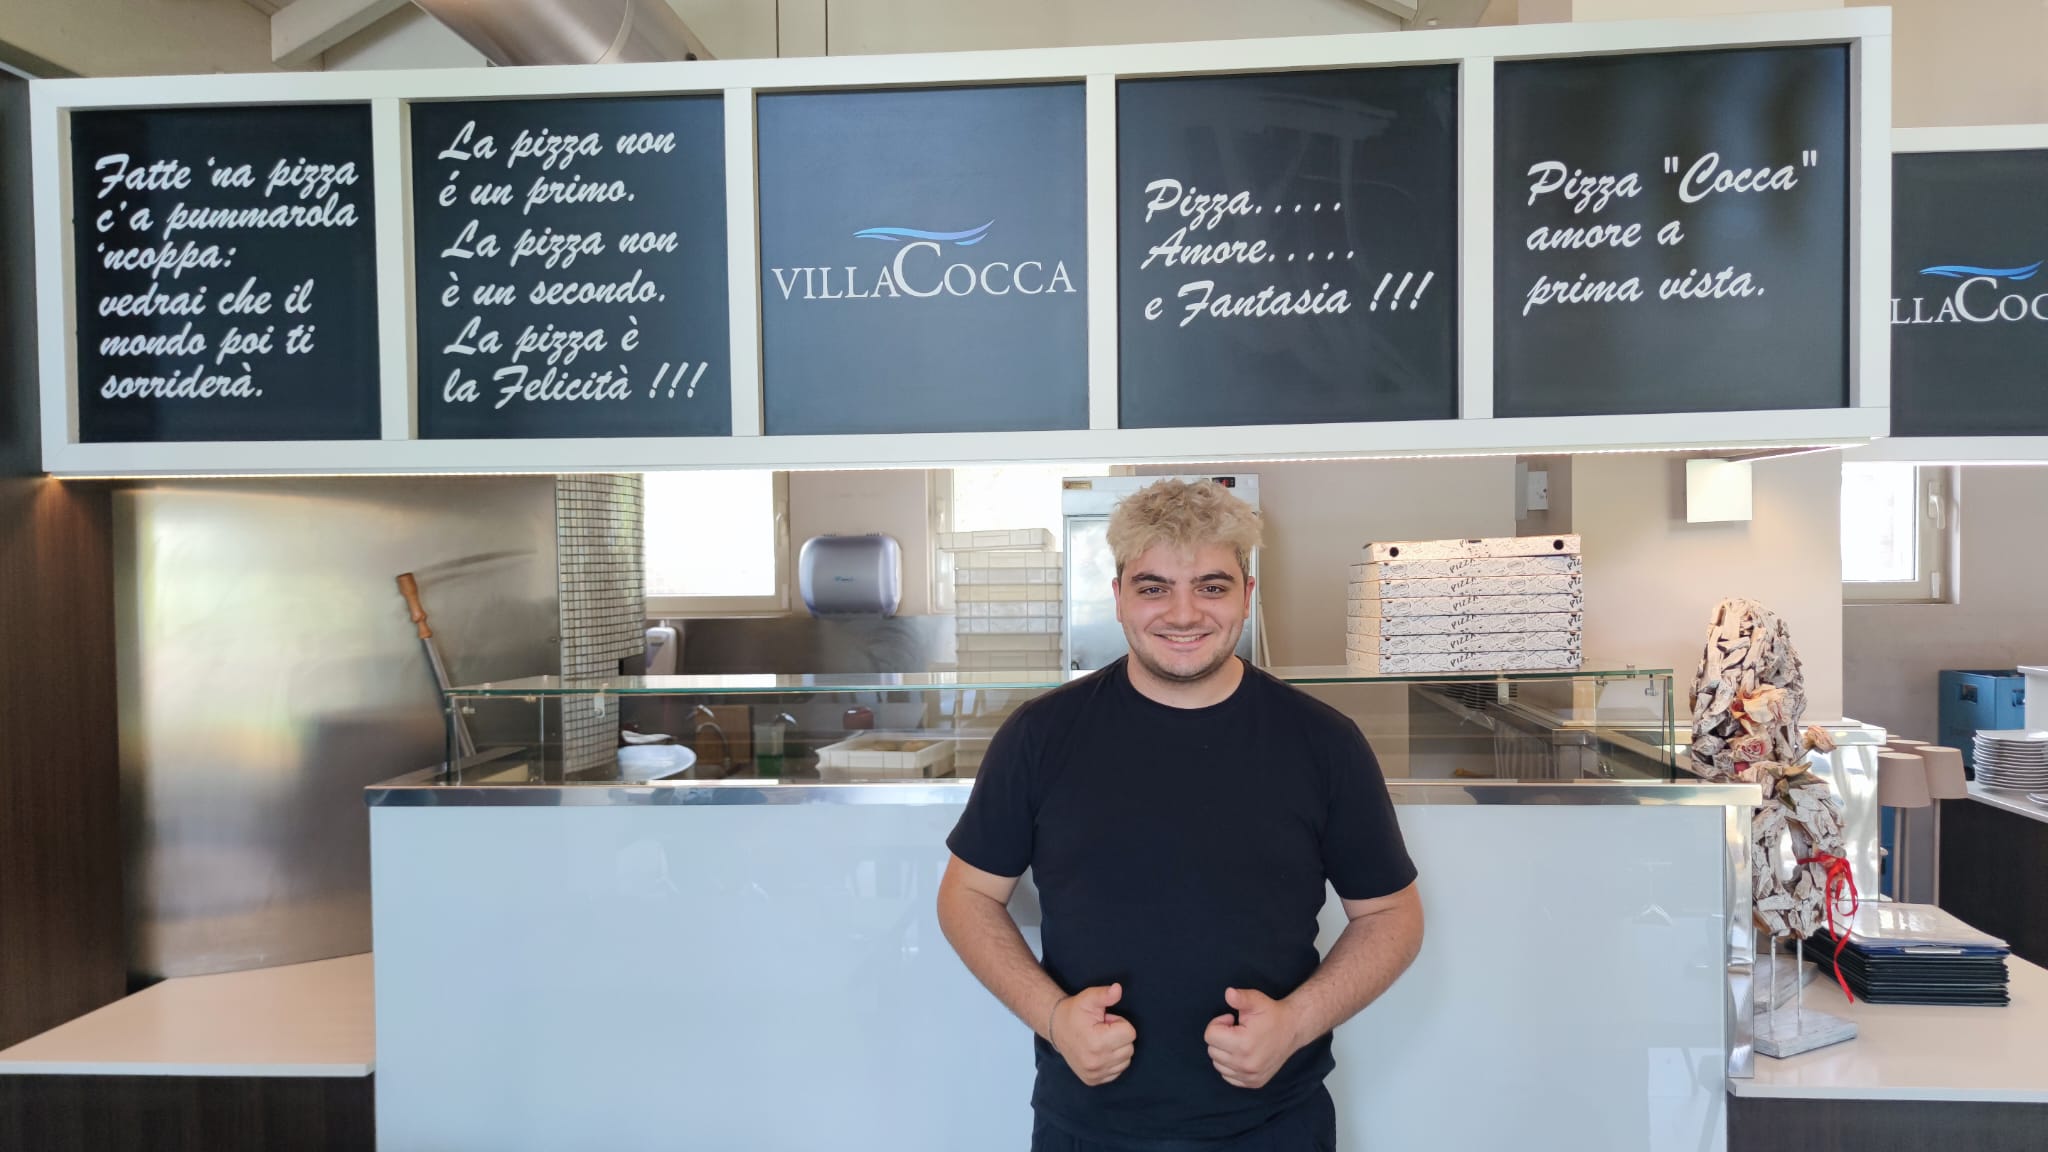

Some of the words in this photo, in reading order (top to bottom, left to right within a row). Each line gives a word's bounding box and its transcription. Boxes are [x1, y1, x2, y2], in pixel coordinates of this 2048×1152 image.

[438, 120, 497, 161] La
[507, 129, 603, 171] pizza
[616, 132, 676, 155] non
[95, 153, 191, 199] Fatte
[265, 159, 359, 200] pizza
[470, 183, 514, 206] un
[523, 174, 635, 215] primo.
[1527, 161, 1642, 214] Pizza
[1663, 150, 1818, 204] "Cocca"
[163, 192, 358, 241] pummarola
[1526, 223, 1642, 251] amore
[1657, 220, 1684, 246] a
[441, 219, 501, 259] La
[510, 227, 606, 269] pizza
[619, 231, 679, 254] non
[99, 282, 207, 316] vedrai
[218, 276, 272, 315] che
[285, 279, 314, 314] il
[473, 284, 516, 306] un
[529, 269, 667, 305] secondo.
[1144, 297, 1163, 321] e
[1177, 280, 1352, 327] Fantasia
[1369, 271, 1435, 311] !!!
[1522, 272, 1644, 317] prima
[1658, 265, 1766, 300] vista.
[100, 321, 206, 356] mondo
[216, 326, 274, 365] poi
[286, 324, 315, 354] ti
[443, 316, 503, 355] La
[512, 324, 608, 366] pizza
[101, 362, 264, 399] sorriderà.
[443, 368, 480, 403] la
[493, 364, 632, 409] Felicità
[649, 362, 708, 399] !!!
